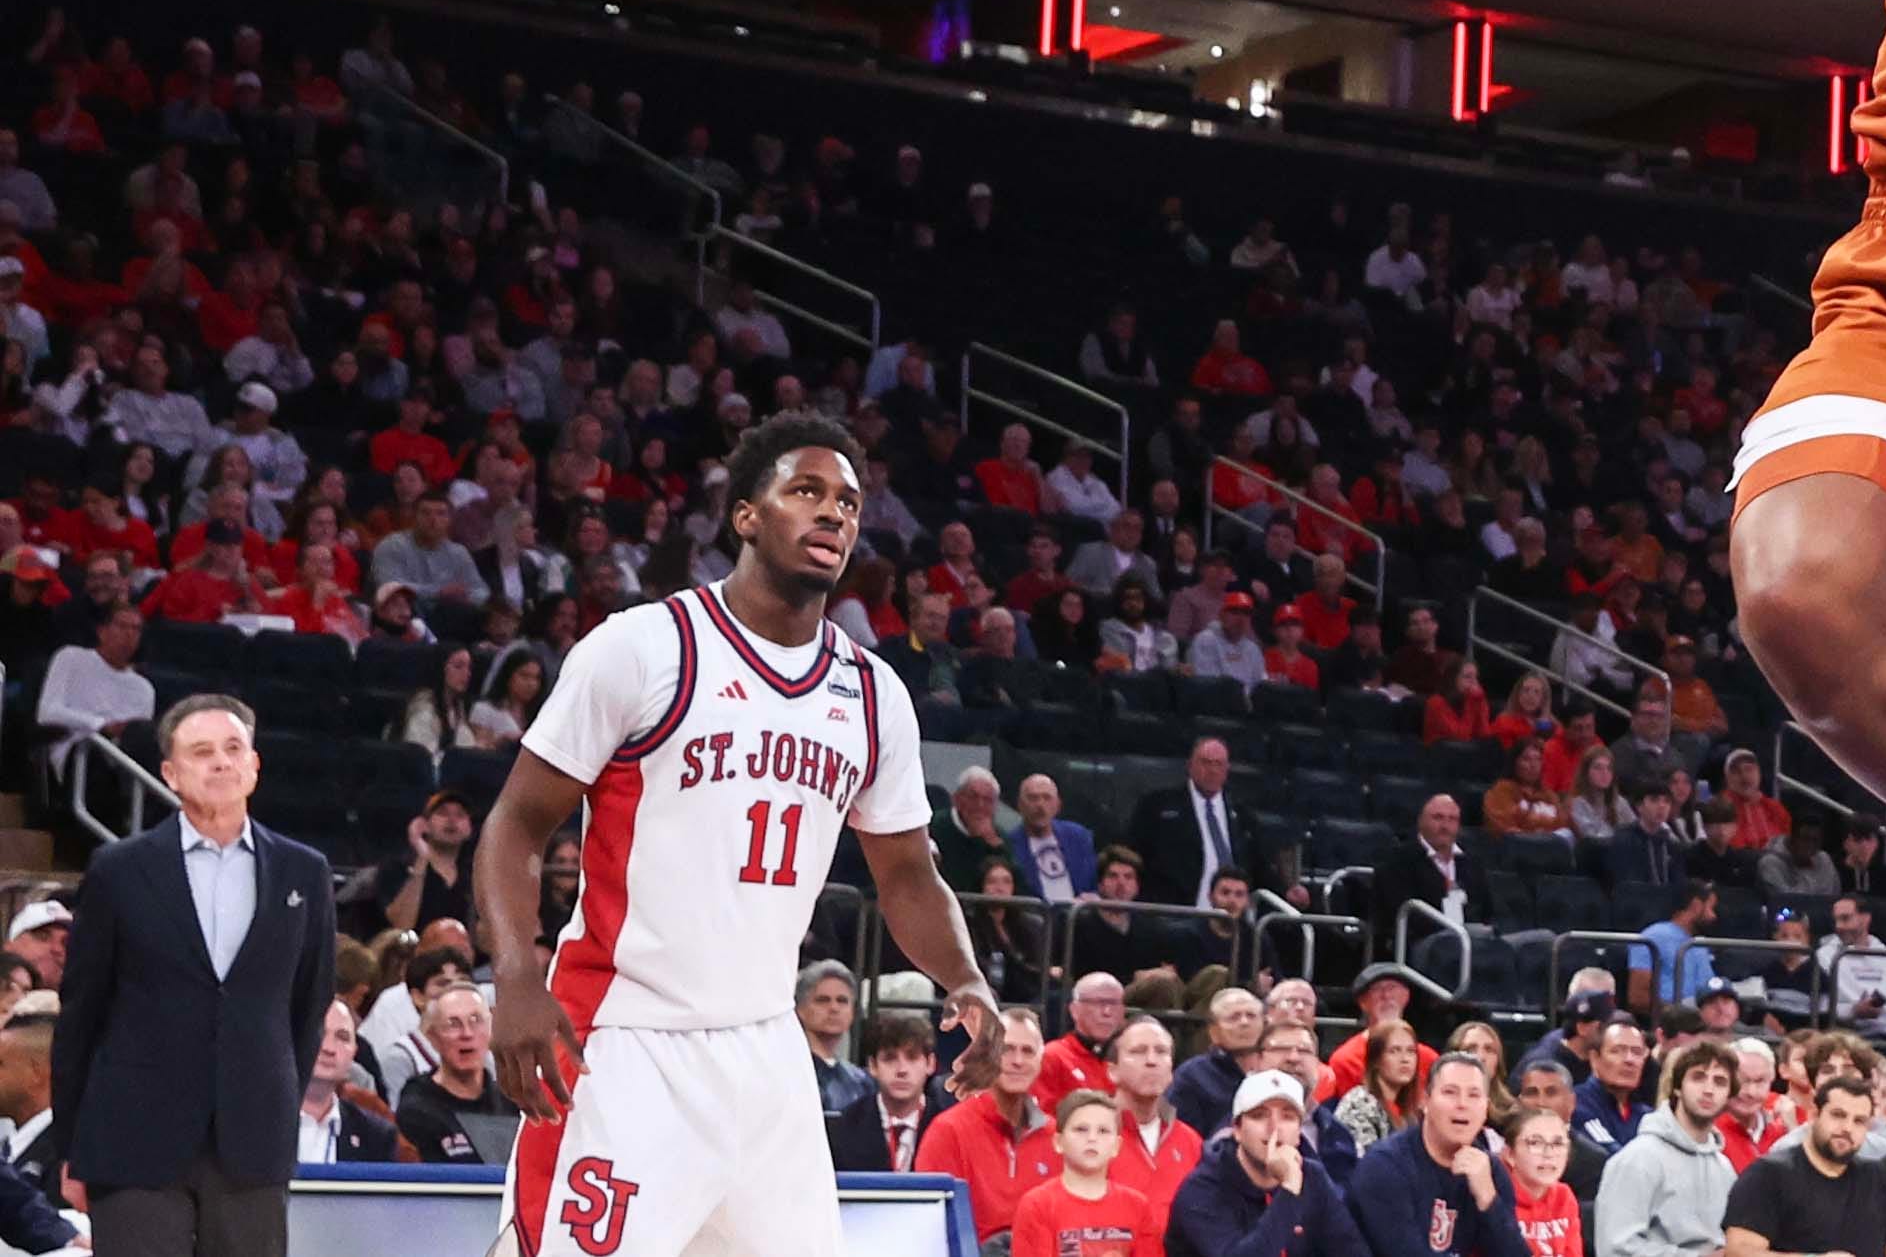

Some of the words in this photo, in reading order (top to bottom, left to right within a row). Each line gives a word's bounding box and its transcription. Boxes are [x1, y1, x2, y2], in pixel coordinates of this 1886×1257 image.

[679, 731, 736, 791] ST.
[746, 730, 860, 814] JOHN'S
[739, 800, 803, 887] 11
